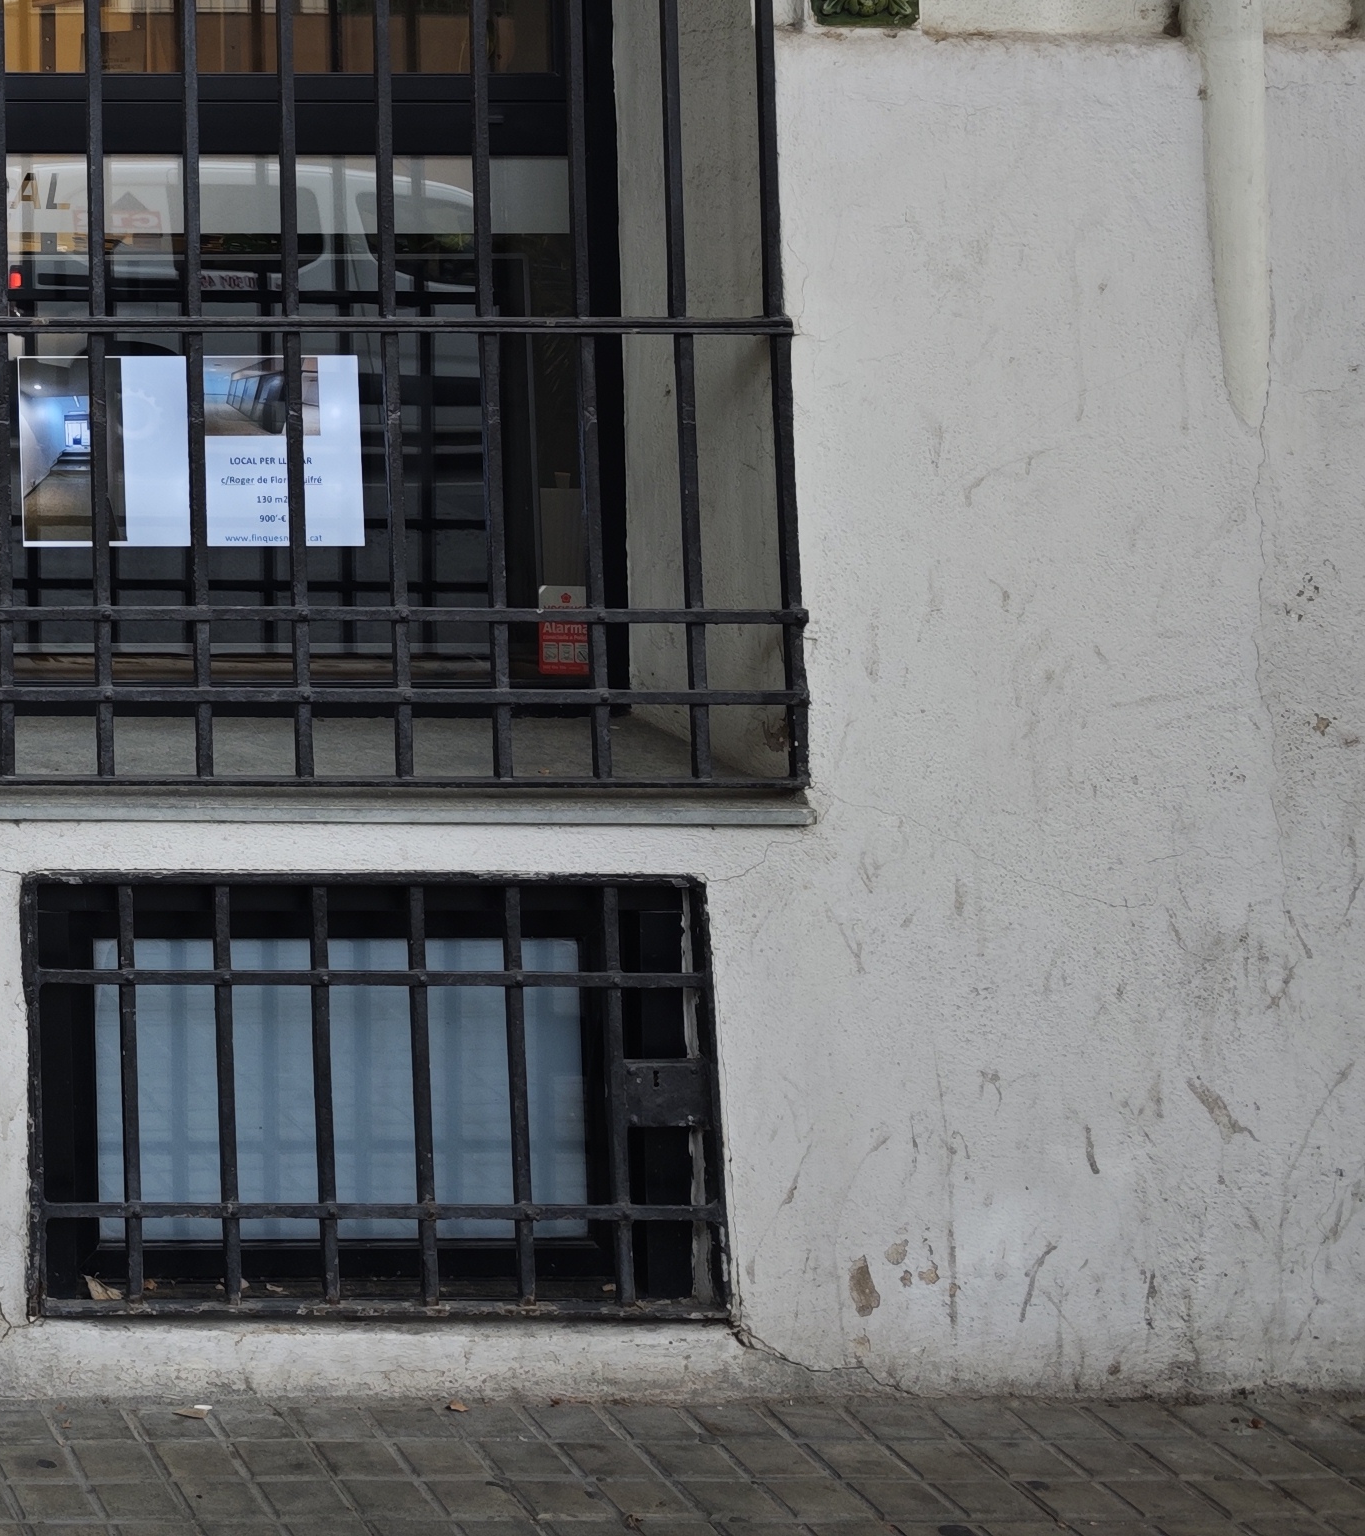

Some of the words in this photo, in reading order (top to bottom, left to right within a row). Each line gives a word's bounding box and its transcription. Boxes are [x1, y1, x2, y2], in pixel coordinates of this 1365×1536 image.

[229, 457, 257, 465] LOCAL
[259, 457, 276, 465] PER
[278, 457, 312, 465] LLAR
[221, 476, 255, 485] c/Roger
[257, 476, 267, 484] de
[257, 495, 272, 504] 130
[275, 495, 288, 504] m2
